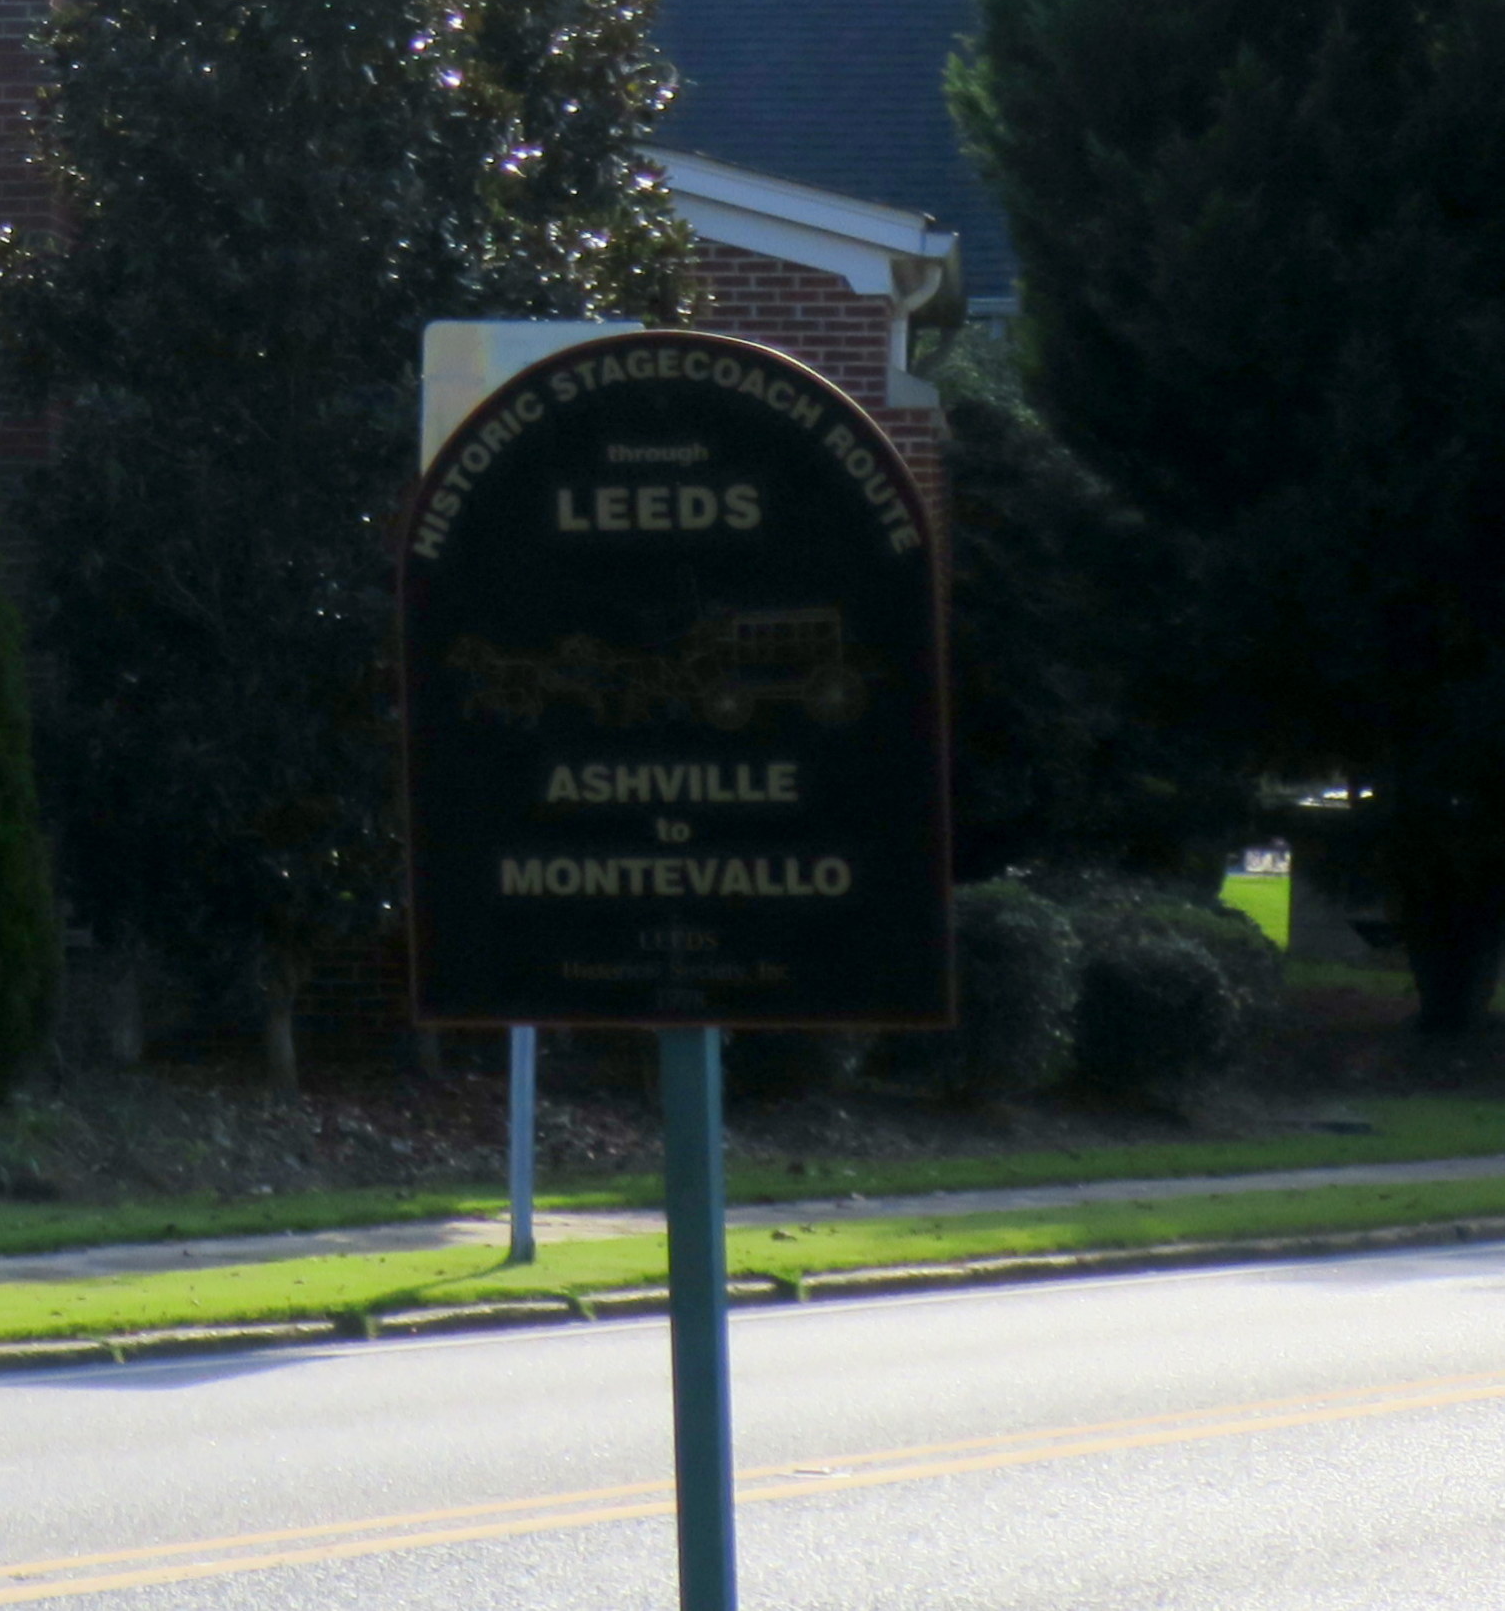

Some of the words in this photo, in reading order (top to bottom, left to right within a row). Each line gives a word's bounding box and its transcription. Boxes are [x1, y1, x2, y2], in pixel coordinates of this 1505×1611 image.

[411, 391, 546, 560] HISTORIC
[549, 348, 824, 430] STAGECOACH
[823, 423, 922, 555] ROUTE
[606, 442, 709, 467] through
[557, 485, 763, 532] LEEDS
[546, 764, 799, 804] ASHVILLE
[656, 817, 691, 844] to
[500, 857, 853, 897] MONTEVALLO
